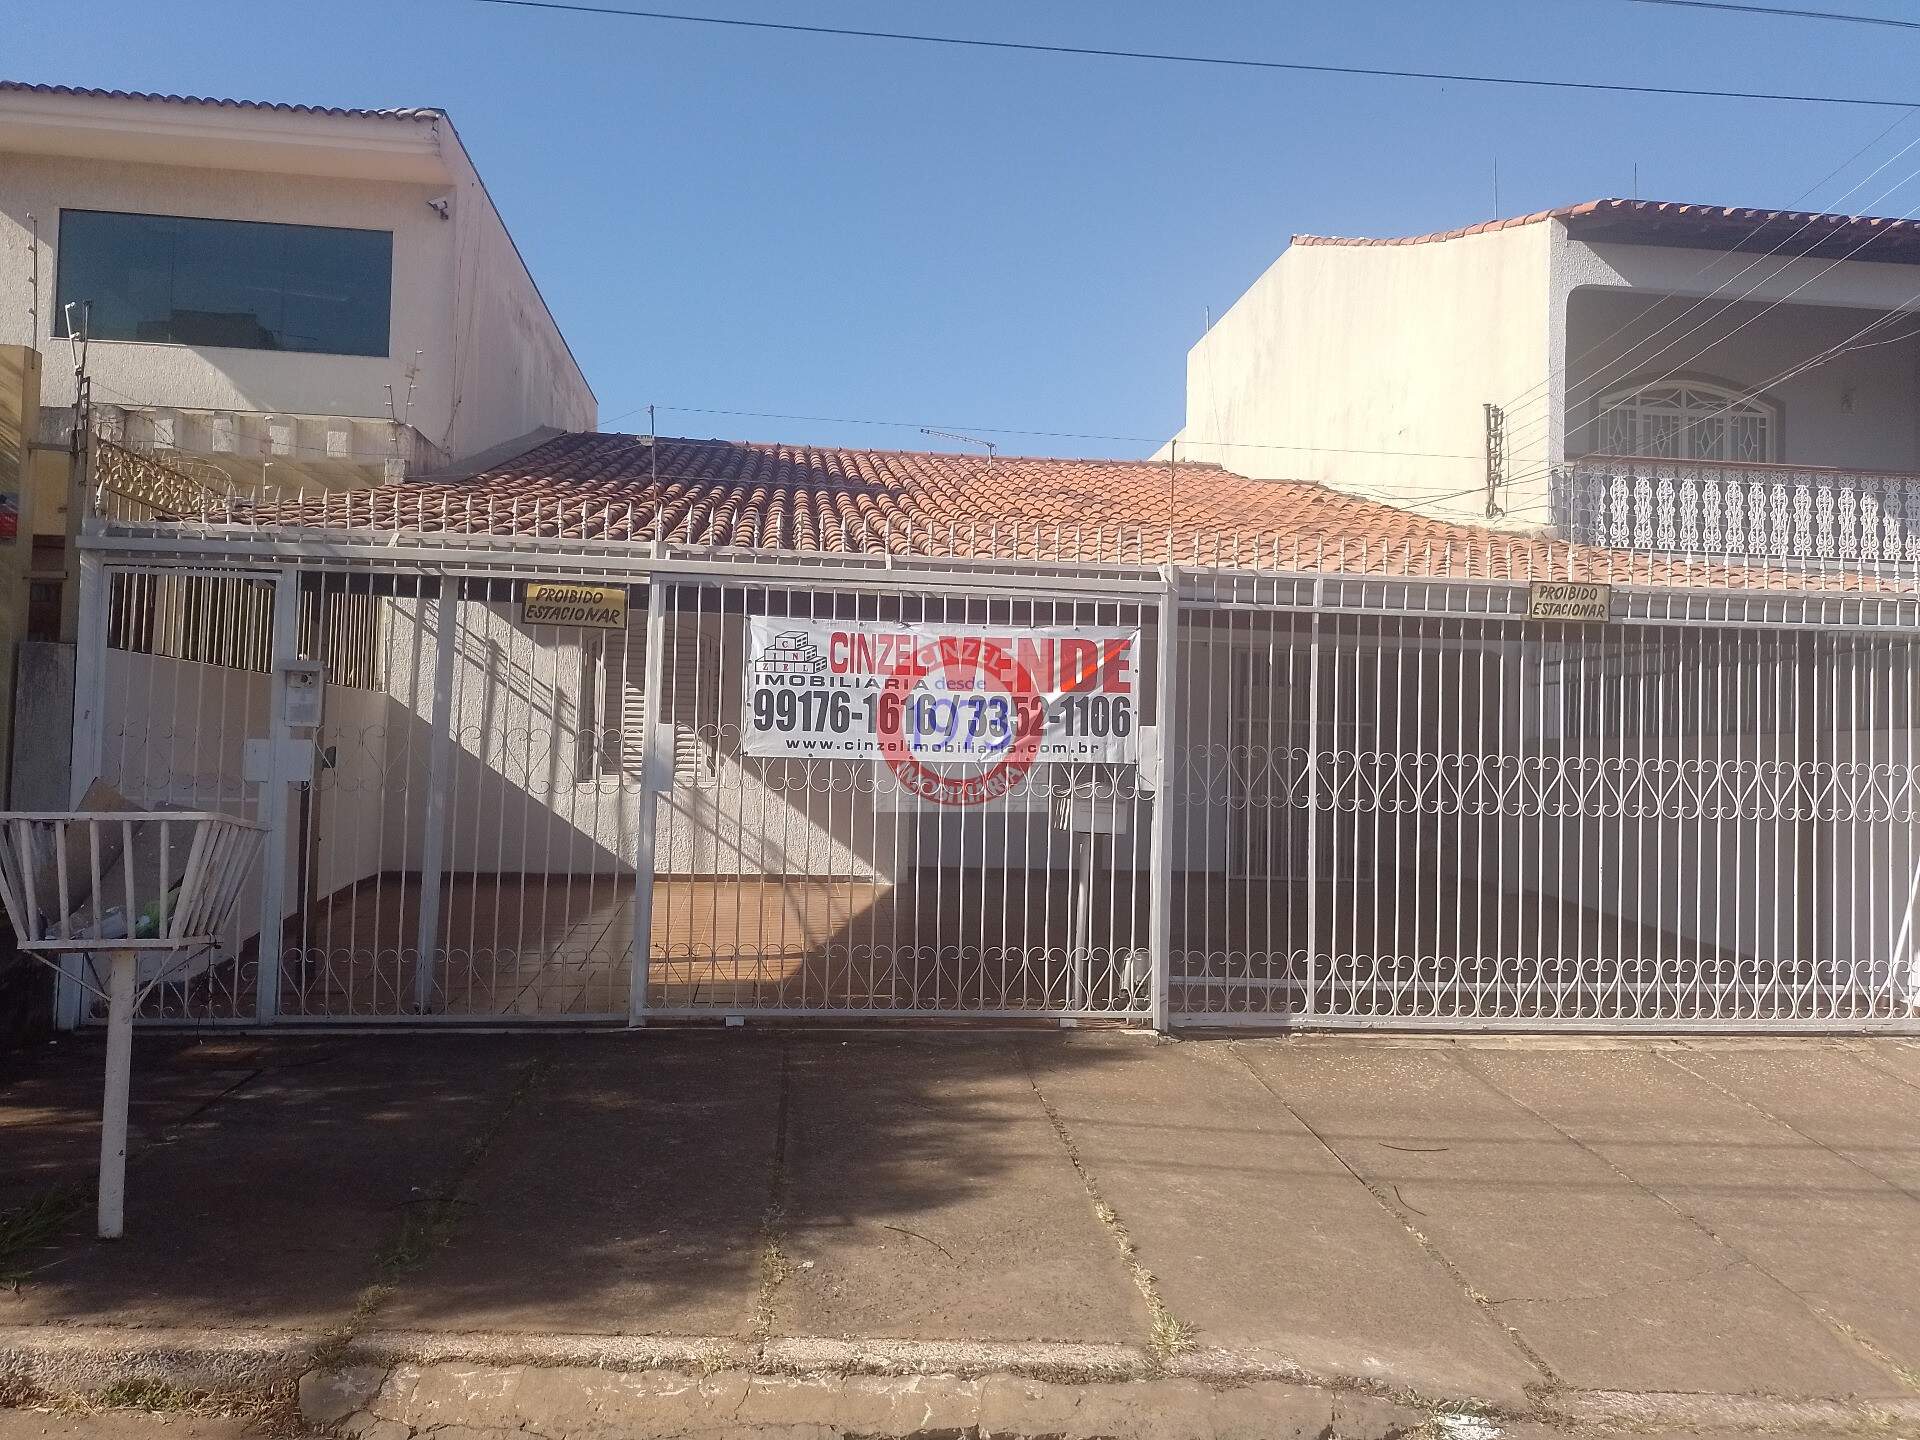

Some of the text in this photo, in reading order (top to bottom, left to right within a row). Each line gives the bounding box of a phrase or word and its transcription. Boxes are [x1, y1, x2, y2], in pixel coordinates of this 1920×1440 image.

[536, 587, 604, 604] PROIBIDO
[1538, 585, 1598, 600] PROIBIDO
[525, 604, 621, 625] ESTACIONAR
[1532, 602, 1605, 618] ESTACIONAR
[830, 631, 1131, 694] CINZEL VENDE
[753, 688, 937, 735] 99176-1616
[967, 695, 1131, 738] 3352-1106
[786, 738, 1099, 754] www.cinzelimobiliaria.com.br
